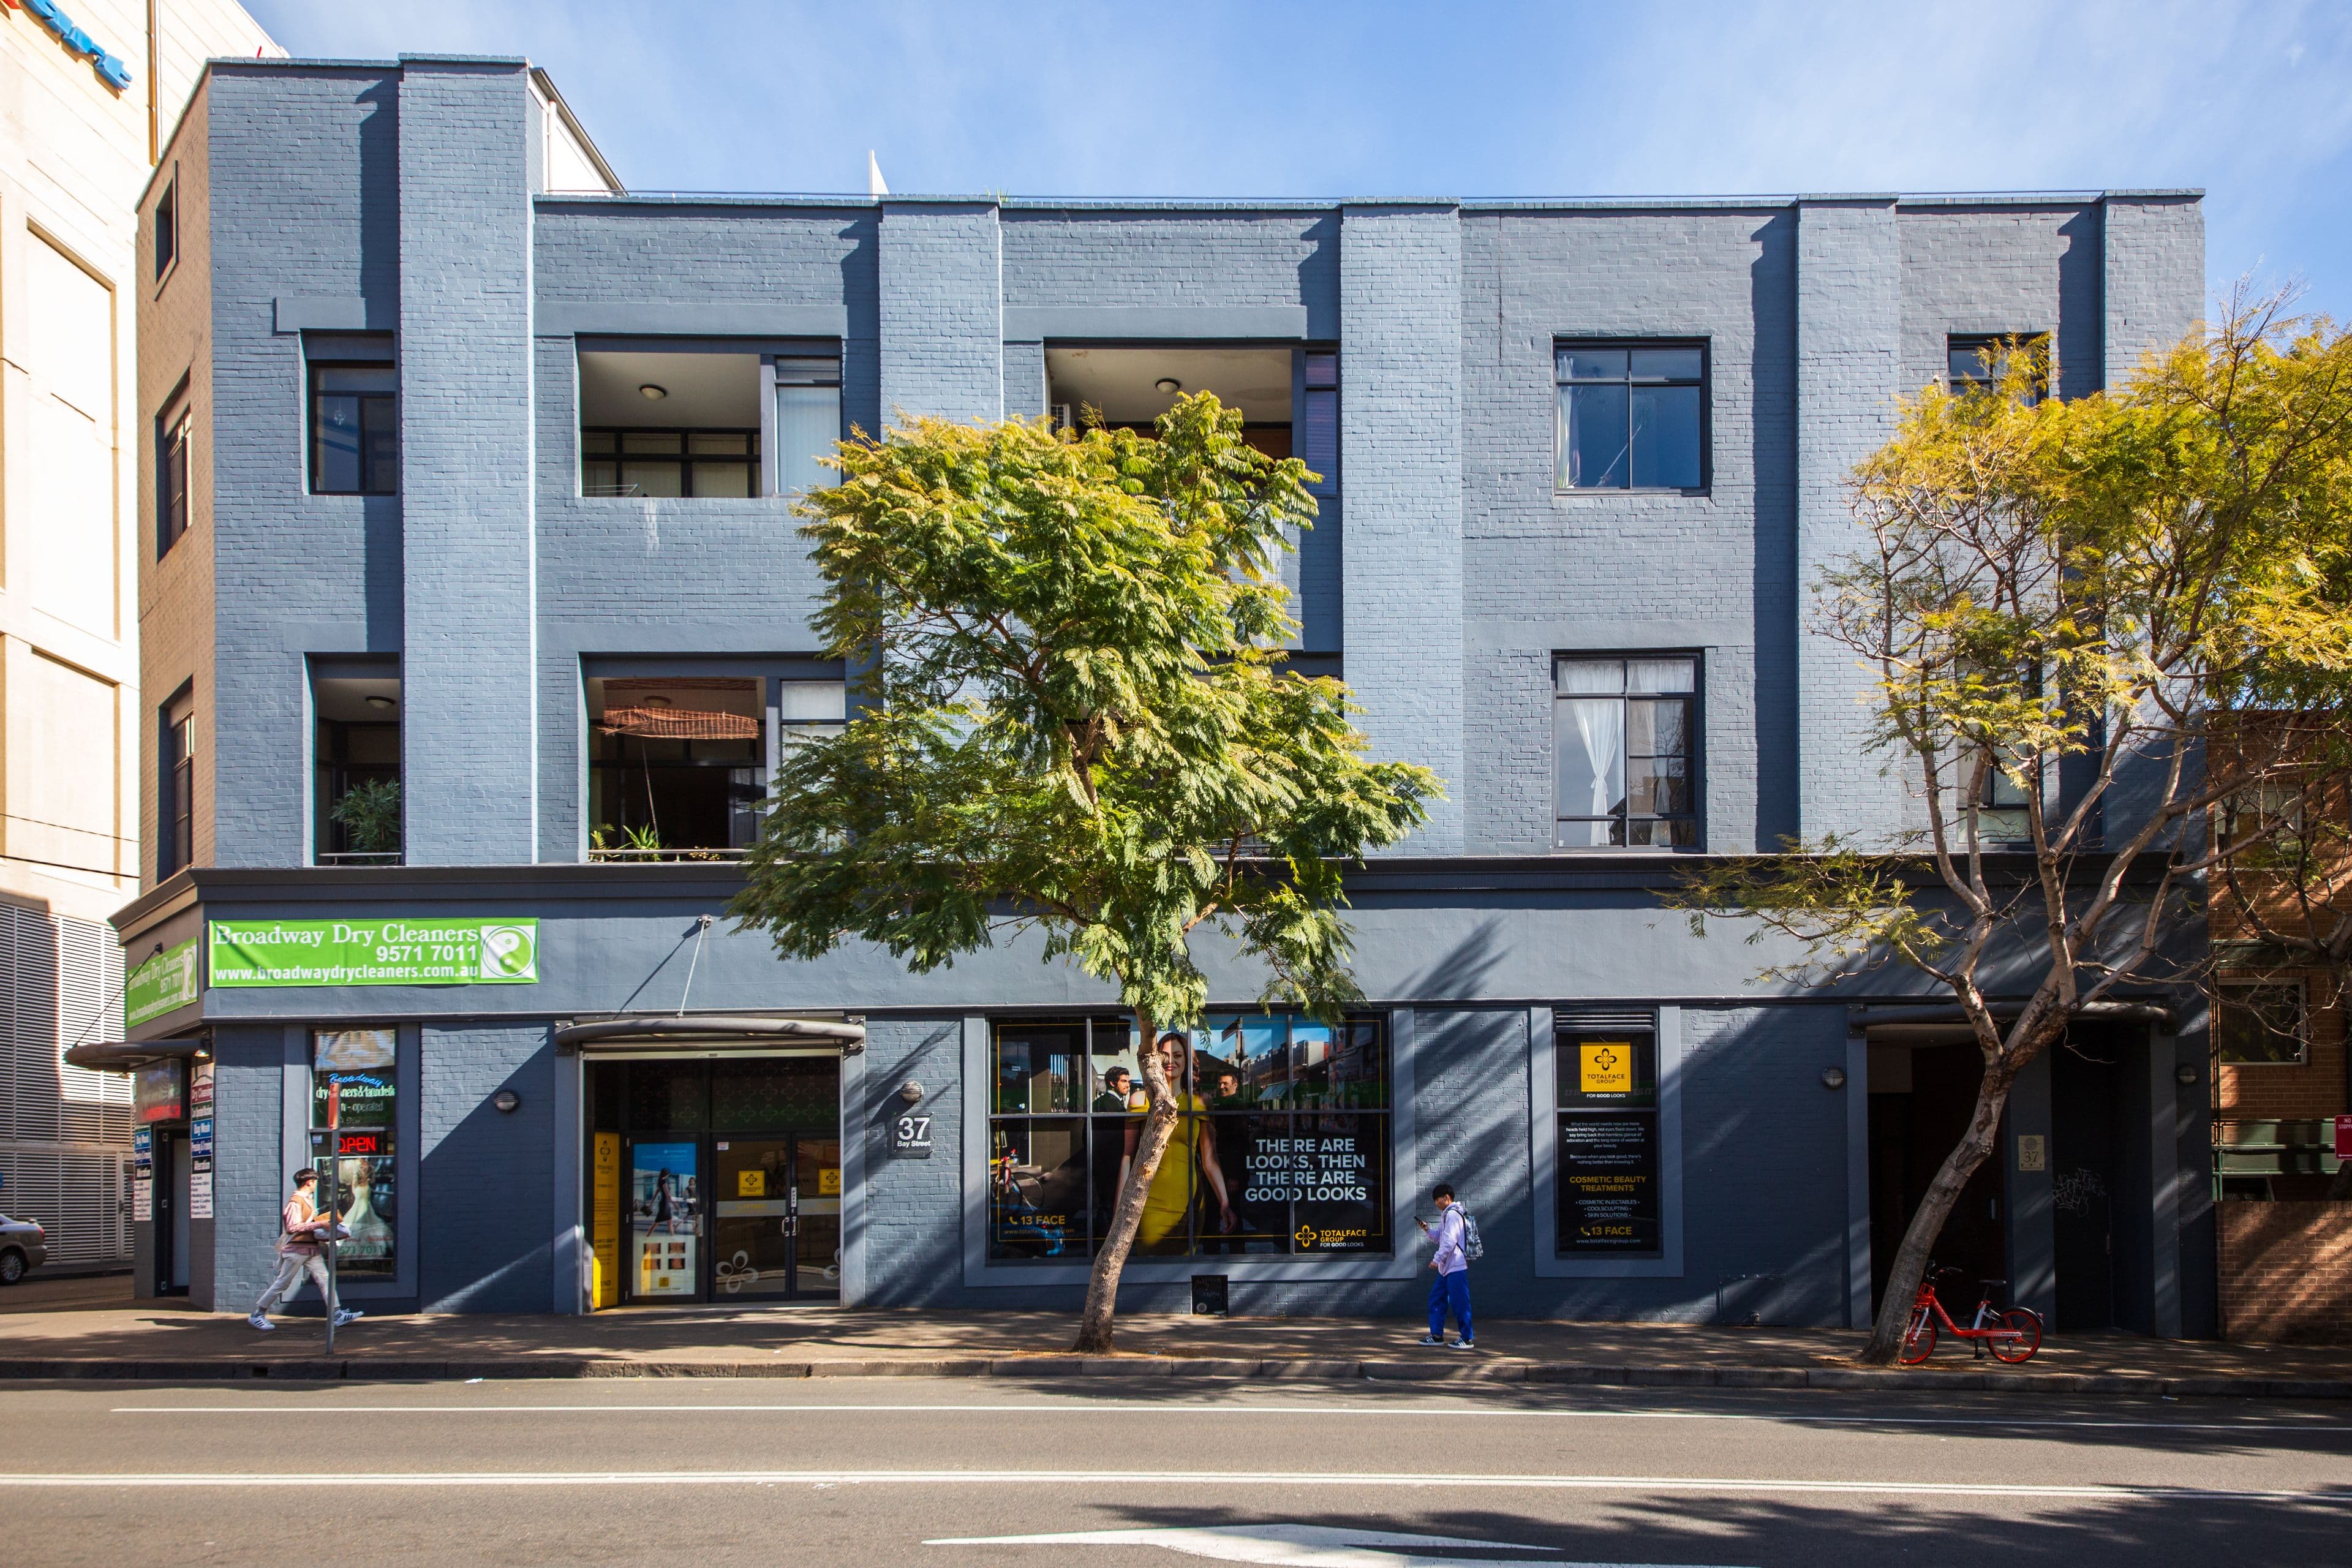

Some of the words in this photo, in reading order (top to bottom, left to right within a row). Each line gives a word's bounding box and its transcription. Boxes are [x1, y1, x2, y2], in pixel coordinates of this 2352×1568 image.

[214, 924, 326, 947] Broadway
[332, 924, 375, 947] Dry
[382, 923, 479, 943] Cleaners
[376, 945, 423, 962] 9571
[431, 944, 477, 962] 7011
[215, 963, 478, 982] www.broadwaydrycleaners.com.au
[329, 1073, 383, 1088] Broadway
[315, 1087, 329, 1099] dry
[898, 1117, 930, 1140] 37
[338, 1136, 376, 1152] OPEN
[1256, 1139, 1316, 1152] THERE
[1320, 1138, 1355, 1152] ARE
[1246, 1155, 1313, 1170] LOOKS,
[1318, 1154, 1365, 1168] THEN
[2023, 1151, 2039, 1163] 37
[1256, 1171, 1316, 1185] THERE
[1320, 1170, 1355, 1185] ARE
[1245, 1187, 1302, 1202] GOOD
[1307, 1186, 1367, 1201] LOOKS
[1020, 1215, 1033, 1225] 13
[1036, 1215, 1066, 1225] FACE
[1591, 1226, 1602, 1235] 13
[1605, 1226, 1632, 1235] FACE
[338, 1245, 356, 1256] 571
